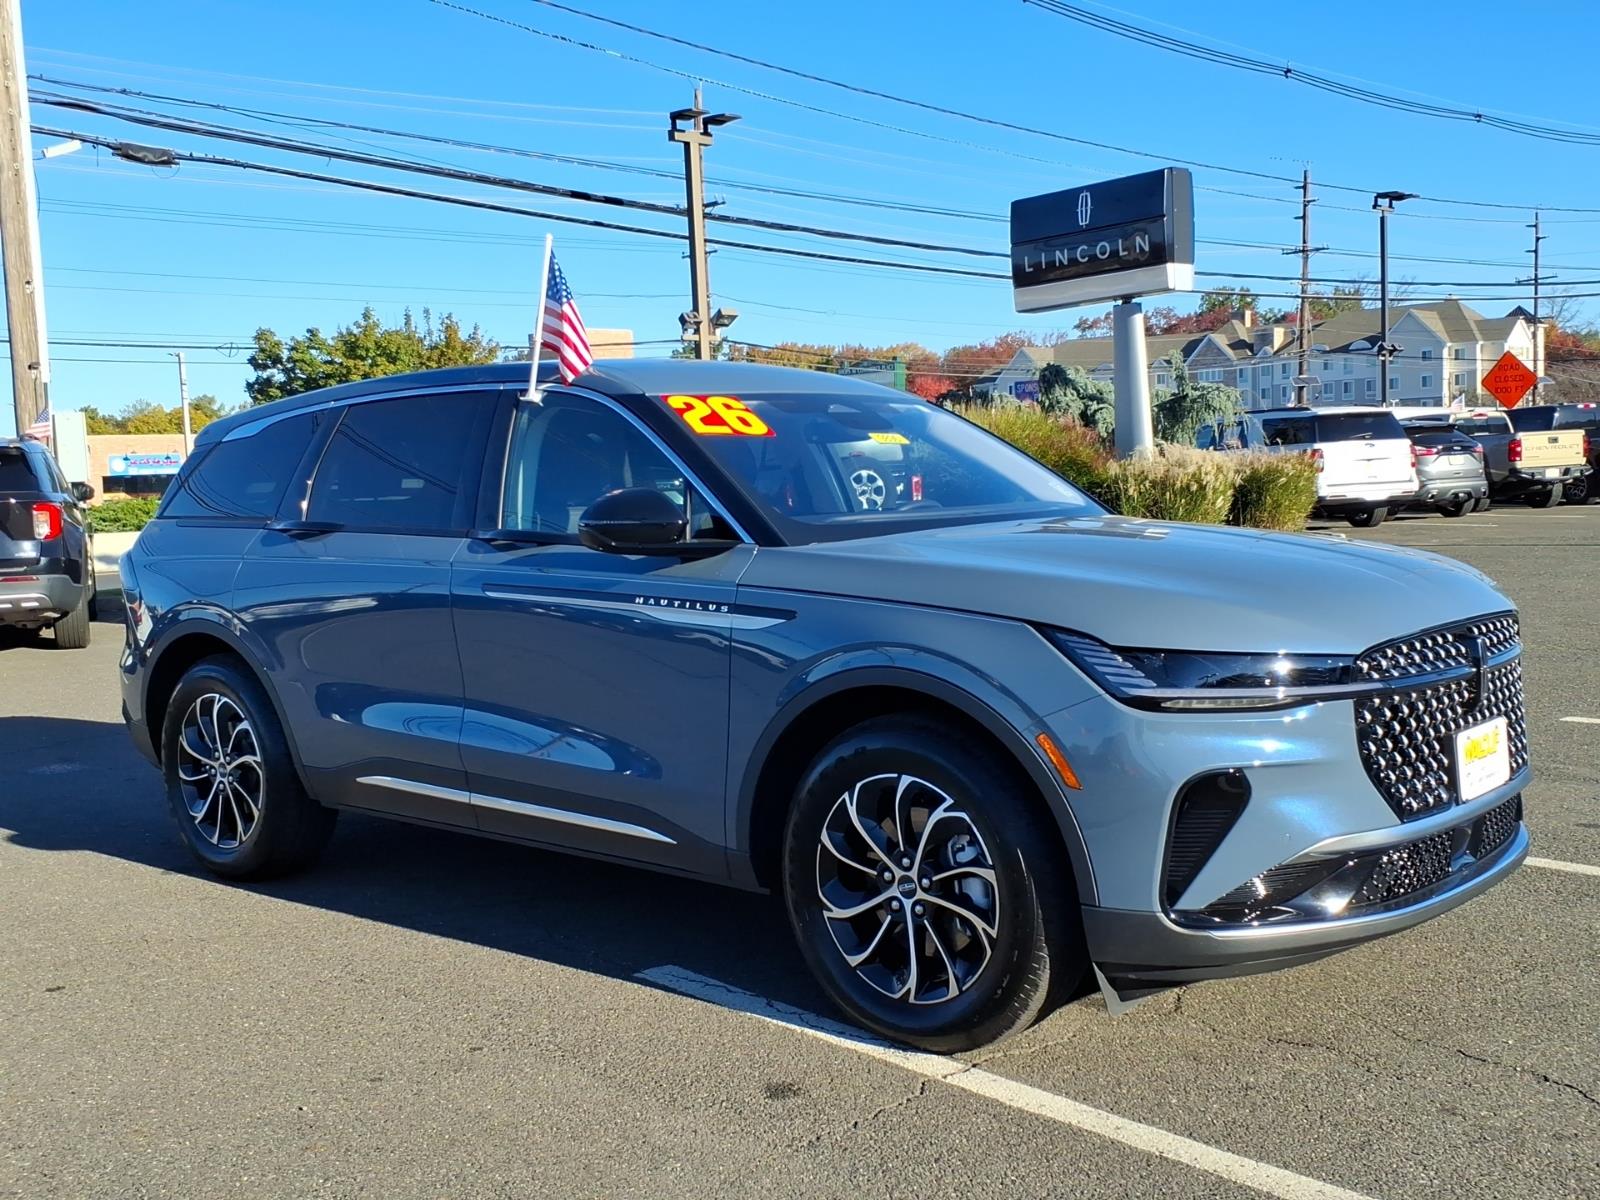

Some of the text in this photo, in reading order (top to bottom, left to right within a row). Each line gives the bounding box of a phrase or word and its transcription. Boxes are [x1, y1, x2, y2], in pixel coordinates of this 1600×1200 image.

[1024, 234, 1150, 273] LINCOLN
[1498, 363, 1520, 371] ROAD
[1494, 375, 1524, 383] CLOSED
[666, 395, 769, 435] 26
[1525, 443, 1580, 451] CHEVROLET
[635, 596, 729, 613] NAUTILUS
